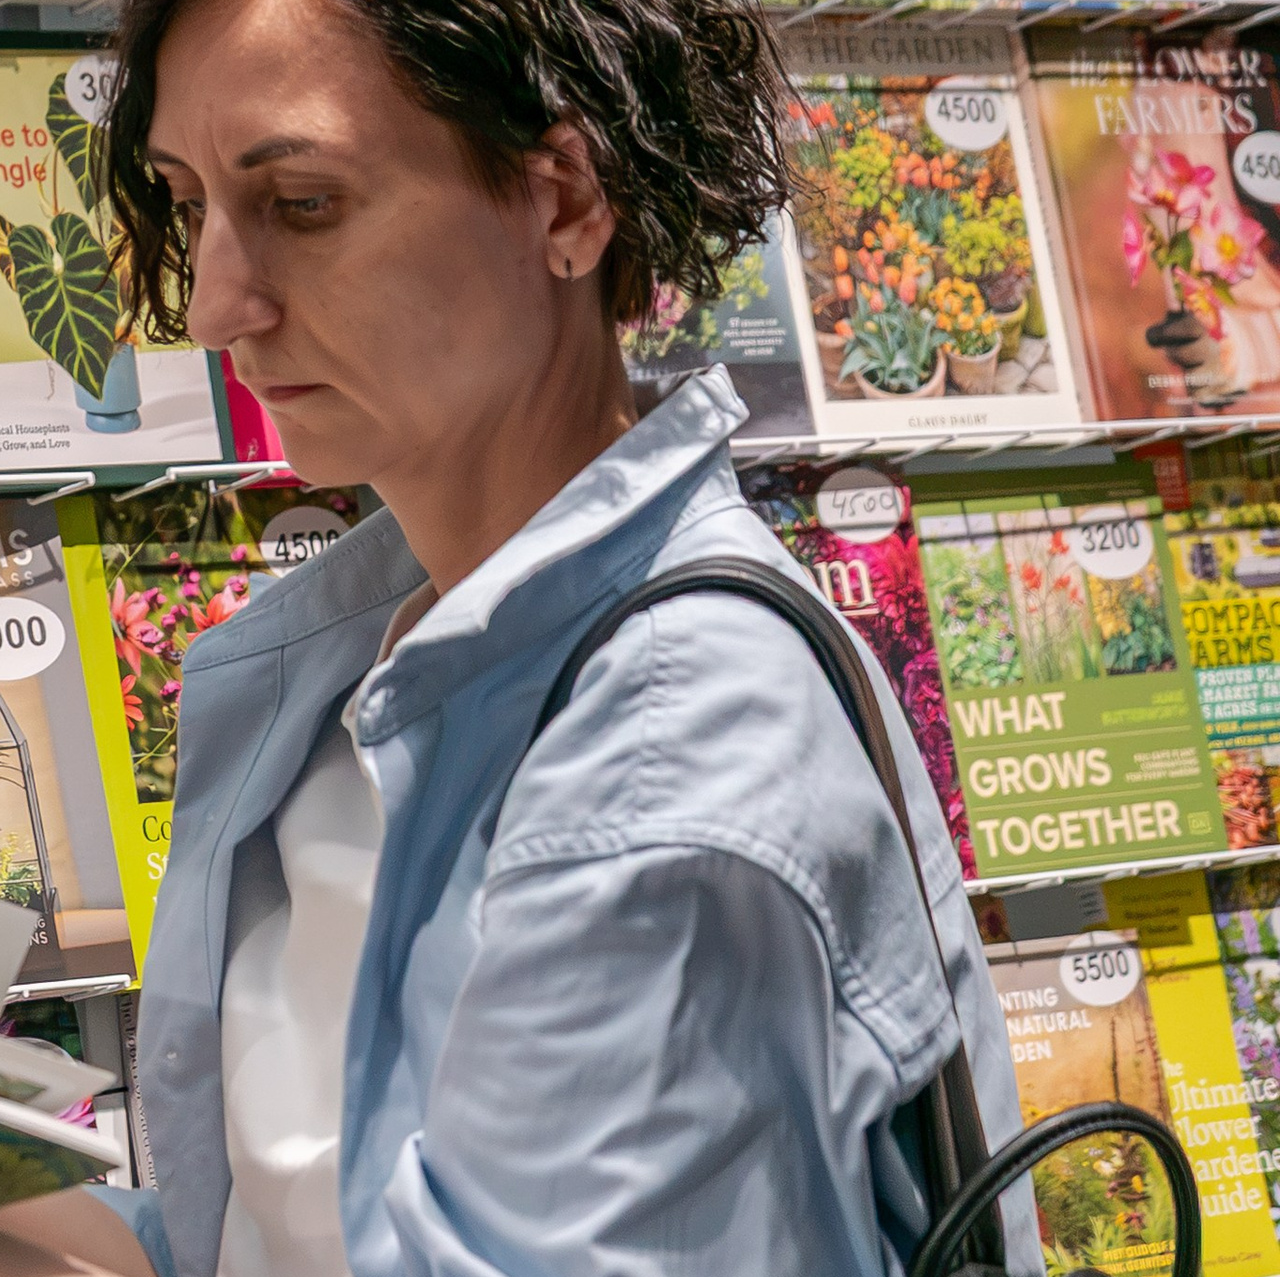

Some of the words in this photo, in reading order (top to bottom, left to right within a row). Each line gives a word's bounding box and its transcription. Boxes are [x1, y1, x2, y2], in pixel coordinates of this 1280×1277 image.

[806, 36, 855, 65] THE
[870, 35, 993, 66] GARDEN
[937, 97, 997, 123] 4500
[1093, 92, 1259, 136] FARMERS
[22, 126, 48, 149] to
[14, 421, 71, 437] Houseplants
[48, 438, 71, 450] Love
[1081, 521, 1141, 553] 3200
[954, 691, 1067, 739] WHAT
[968, 746, 1113, 799] GROWS
[976, 799, 1183, 859] TOGETHER
[1073, 949, 1130, 984] 5500
[1007, 1009, 1093, 1038] NATURAL
